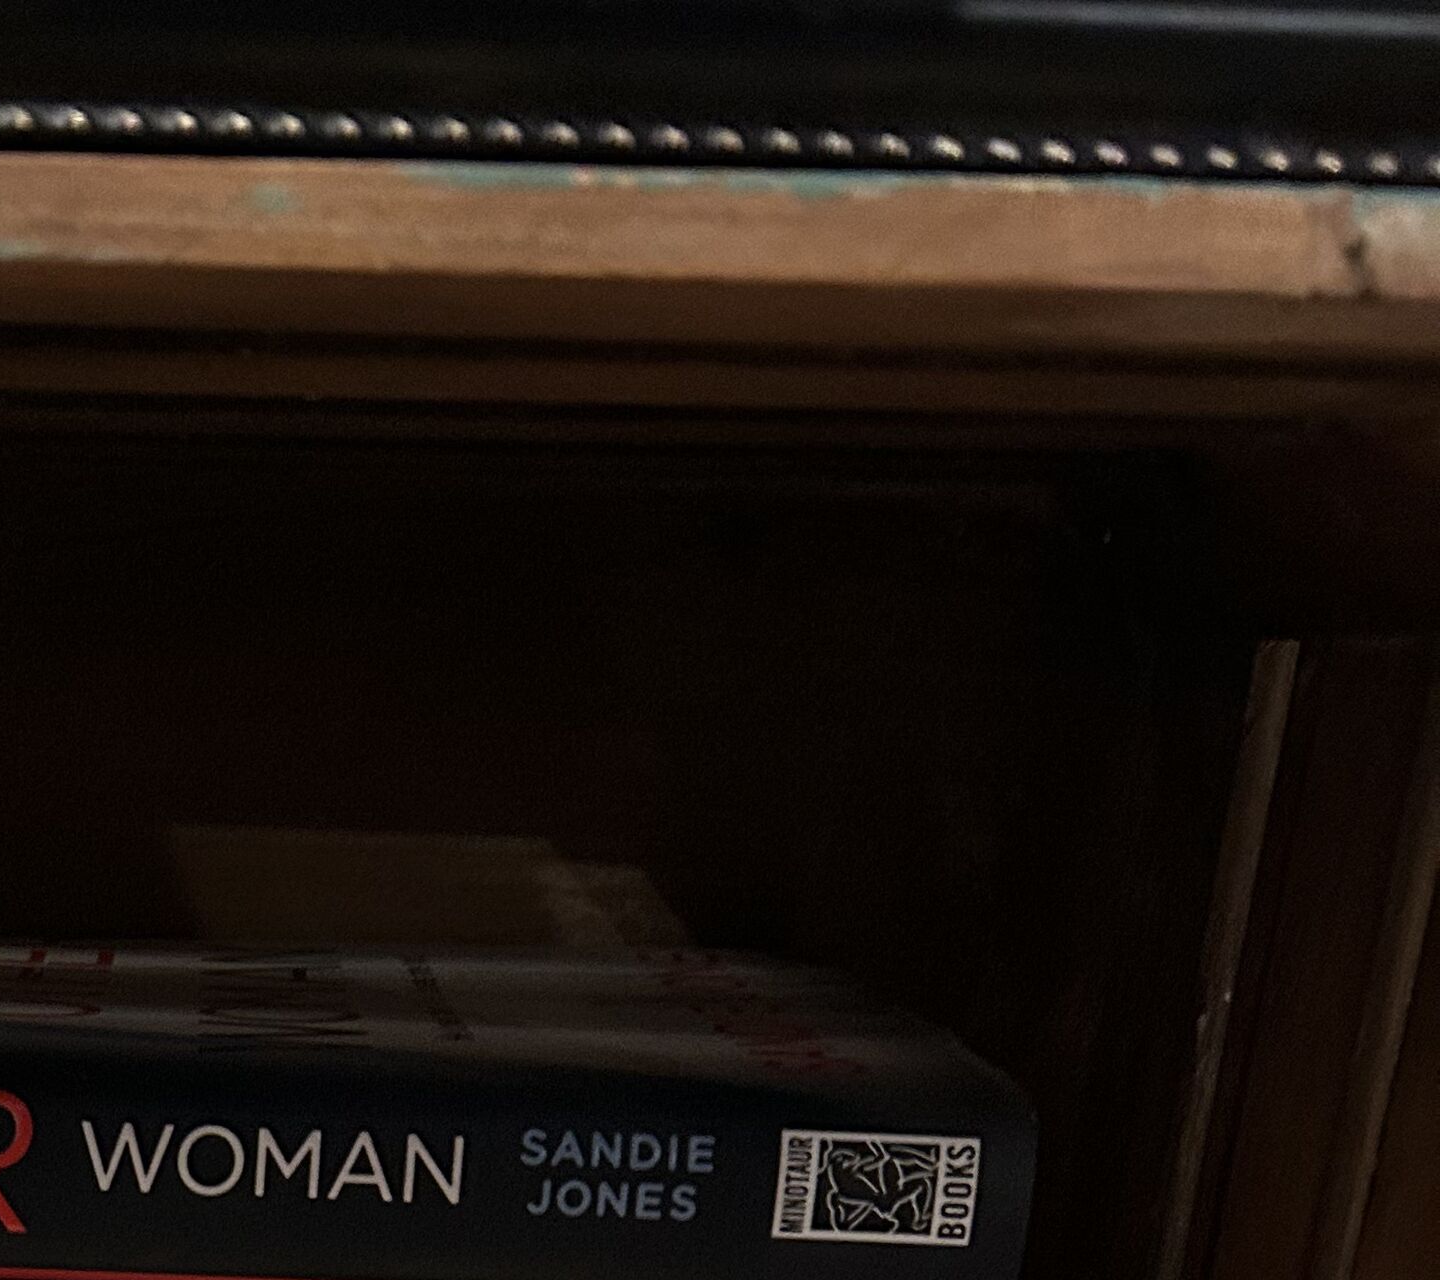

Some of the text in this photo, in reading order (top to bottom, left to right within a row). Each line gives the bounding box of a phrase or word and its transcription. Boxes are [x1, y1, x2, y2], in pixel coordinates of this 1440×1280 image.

[81, 1118, 465, 1205] WOMAN
[520, 1128, 717, 1174] SANDIE
[779, 1136, 813, 1234] MINOTAUR
[937, 1144, 976, 1239] BOOKS
[526, 1180, 698, 1222] JONES
